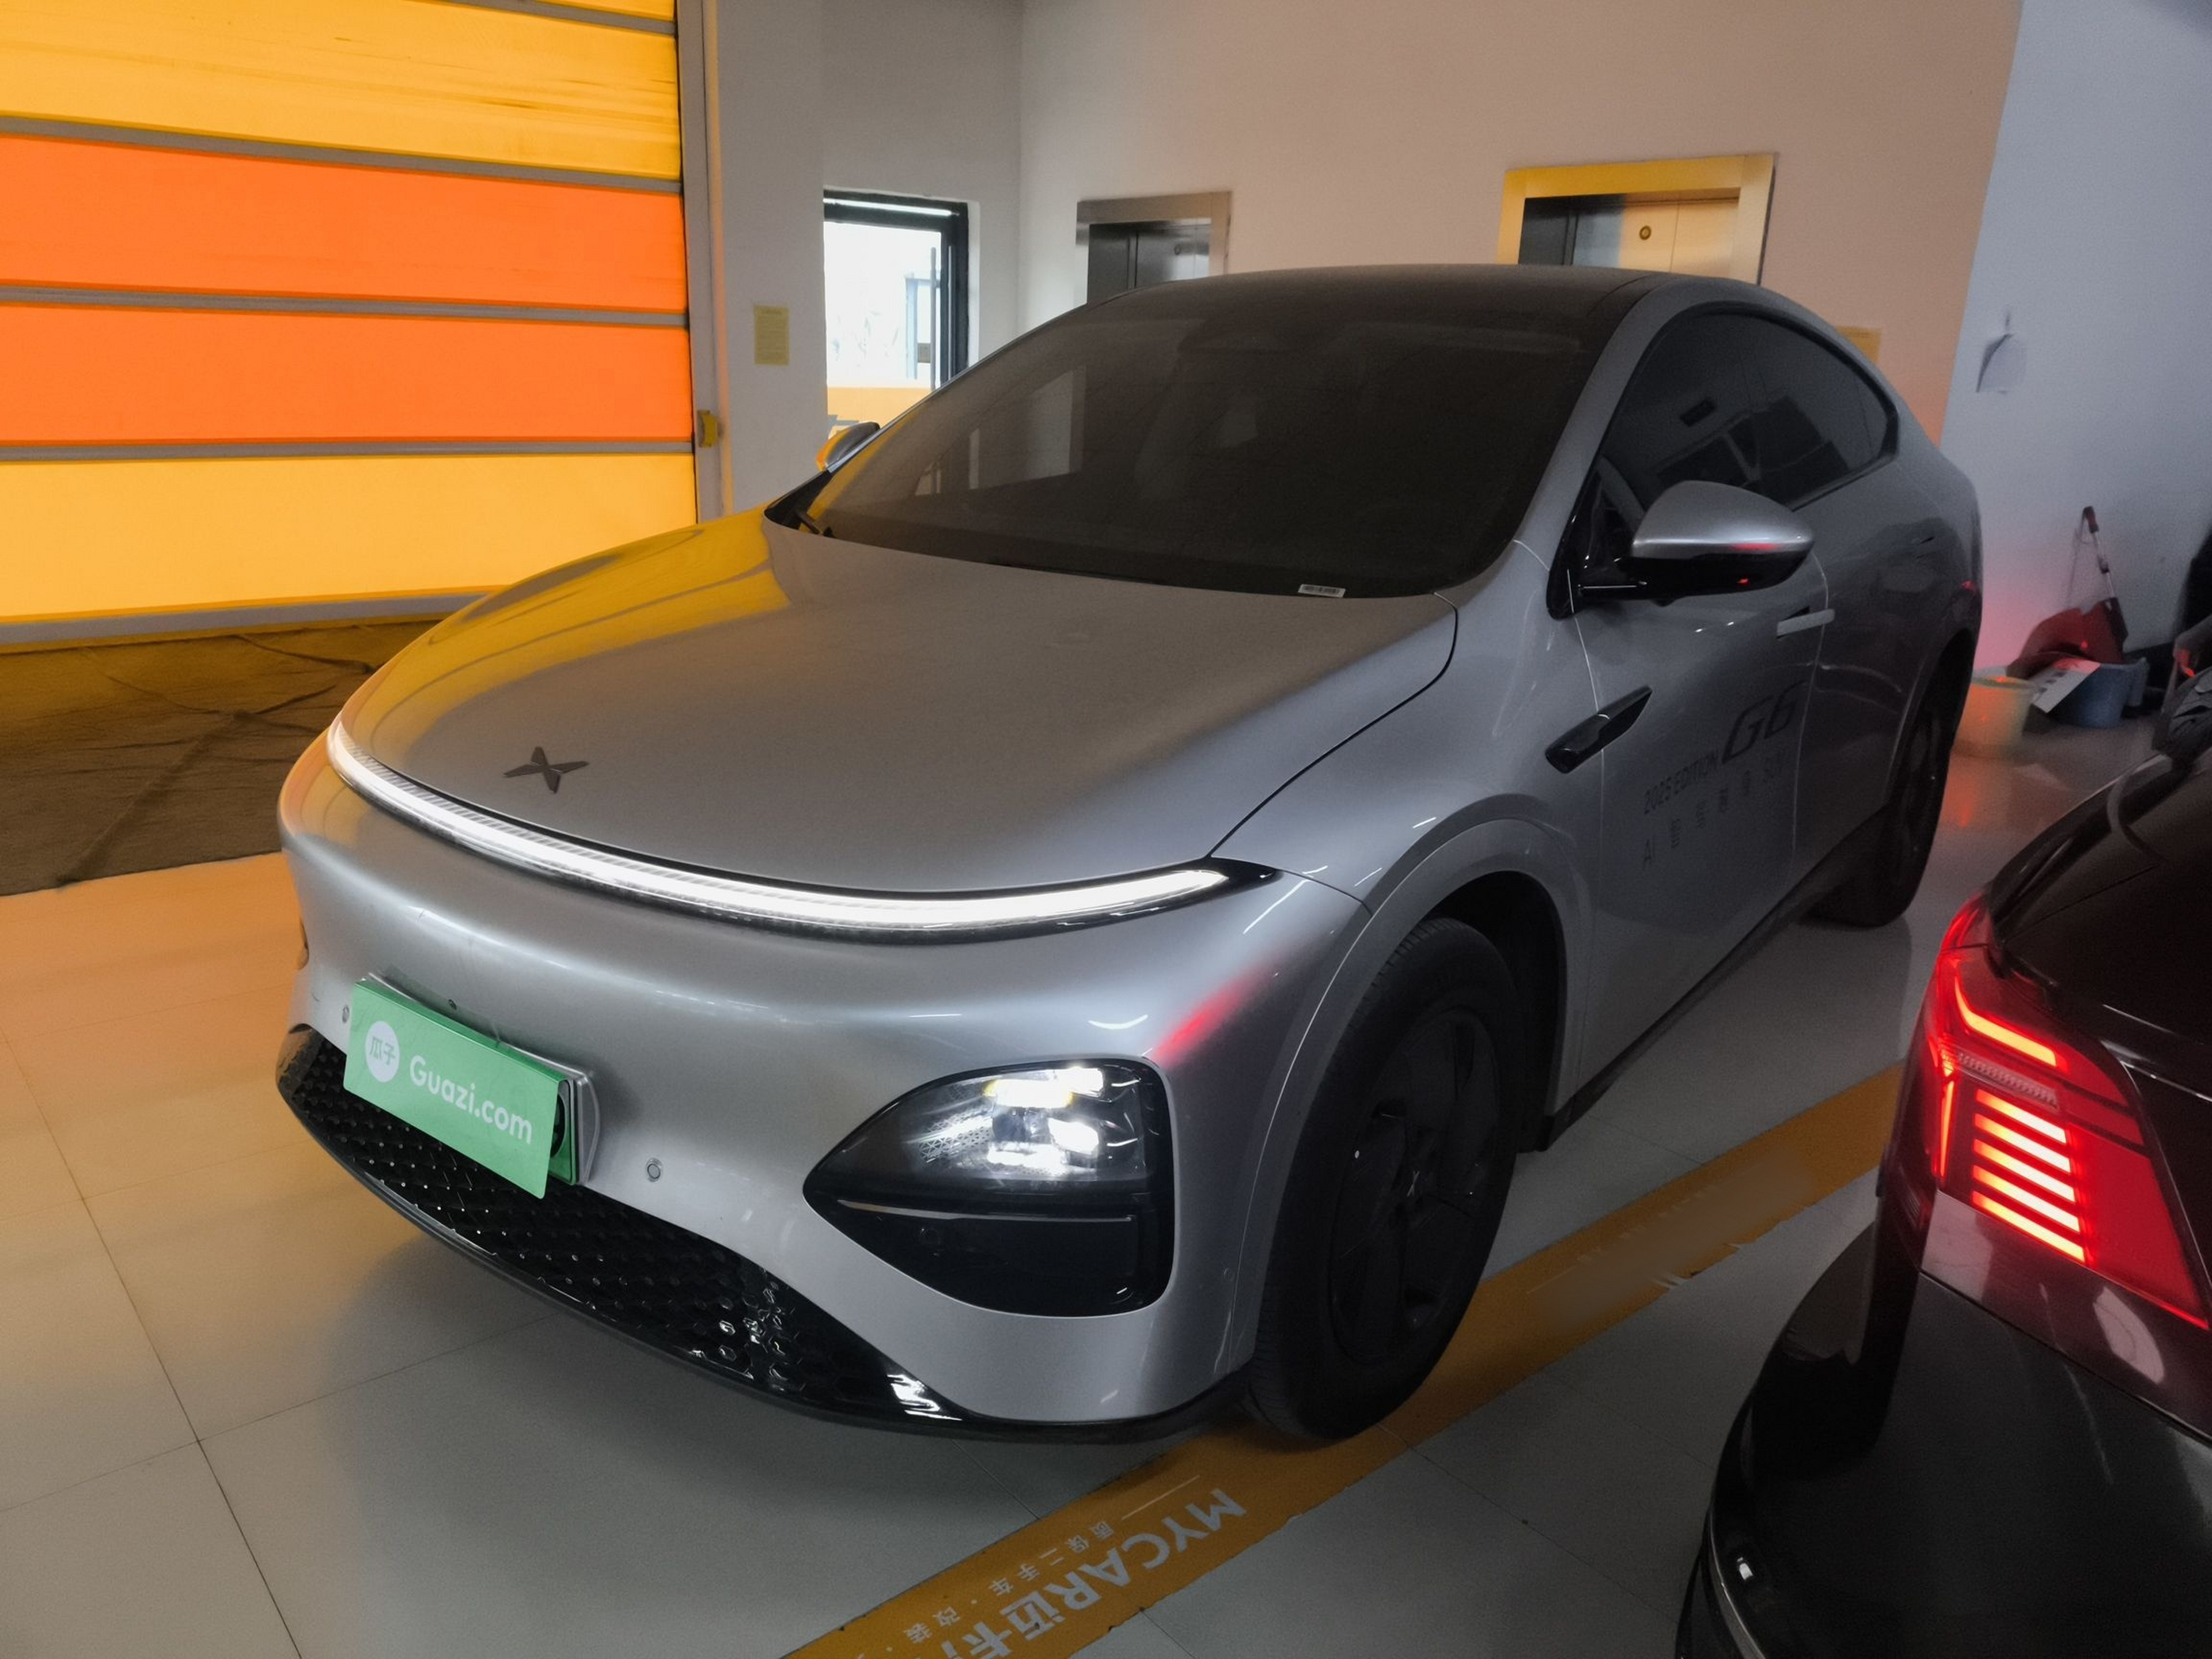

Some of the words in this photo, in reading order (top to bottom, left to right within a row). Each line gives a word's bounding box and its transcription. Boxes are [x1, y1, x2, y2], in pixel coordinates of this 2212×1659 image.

[1721, 679, 1807, 765] G6
[369, 1036, 396, 1065] 瓜子
[410, 1055, 533, 1145] Guazi.com
